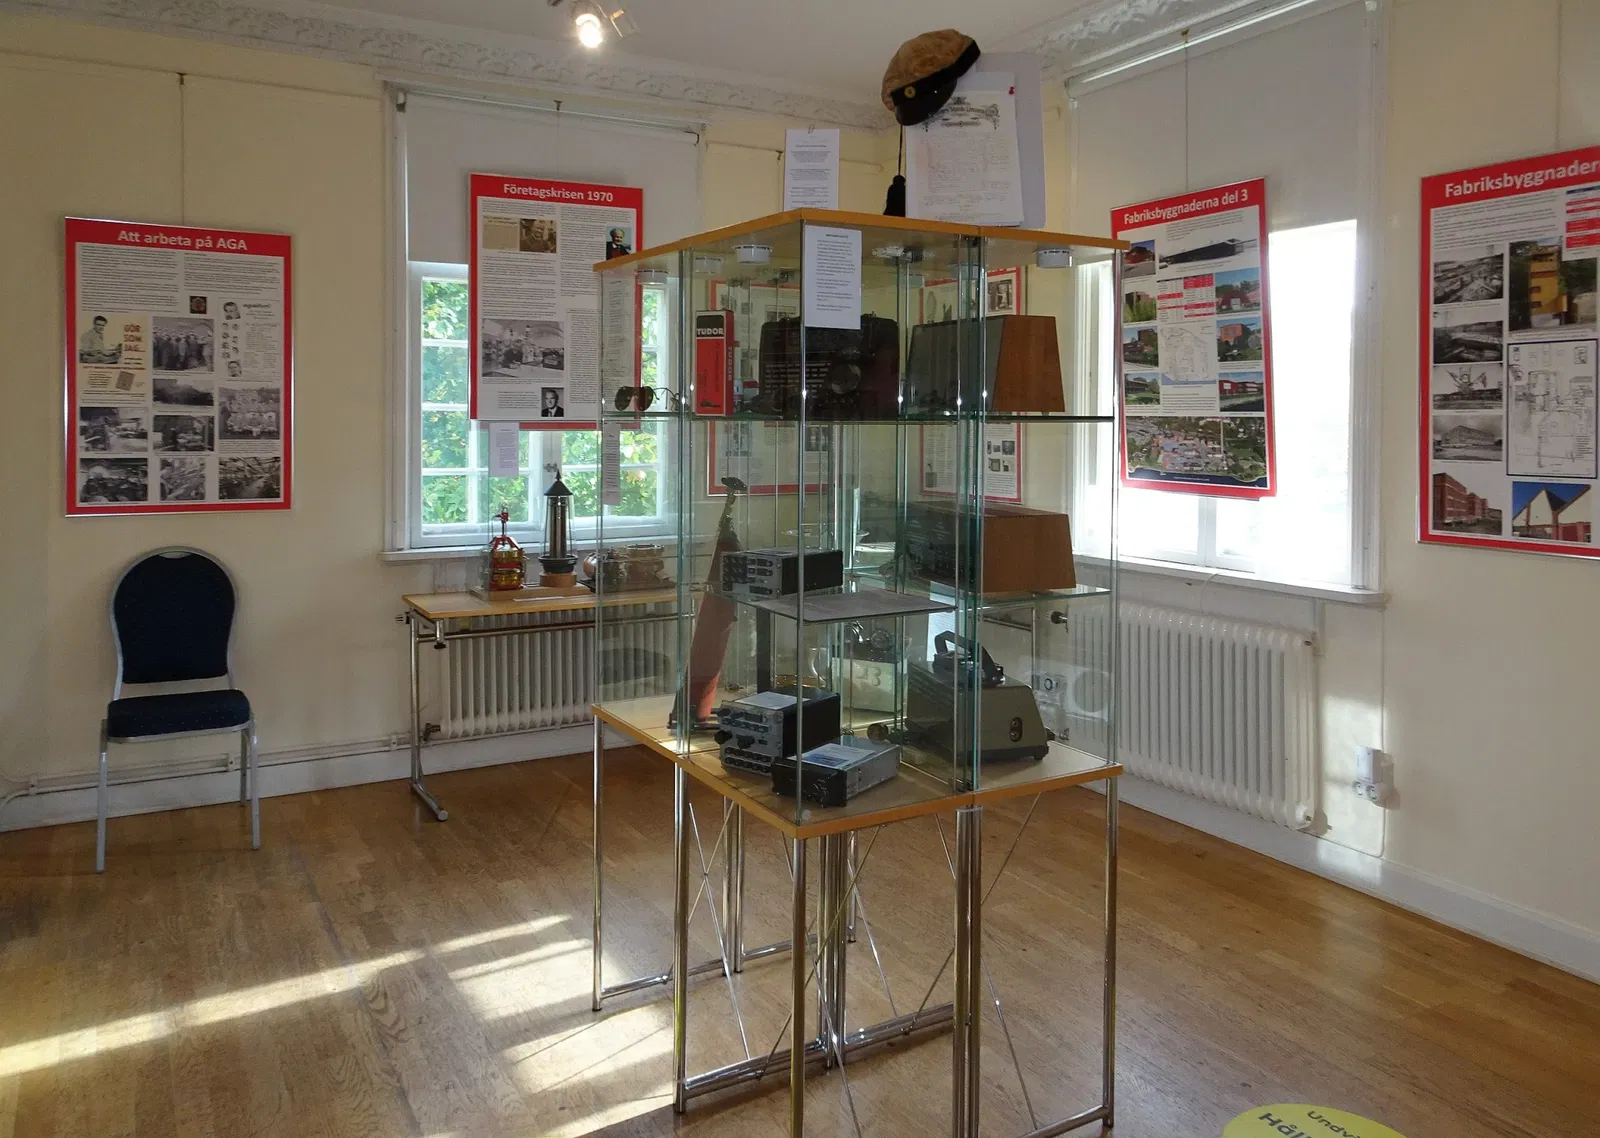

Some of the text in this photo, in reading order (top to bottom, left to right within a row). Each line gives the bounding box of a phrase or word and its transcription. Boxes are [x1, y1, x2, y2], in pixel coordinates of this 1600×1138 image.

[503, 183, 614, 203] Företagskrisen 1970
[1445, 160, 1600, 198] Fabriksbyggnader
[1124, 188, 1249, 225] Fabriksbyggnaderna del 3
[118, 230, 247, 251] Att arbeta på AGA
[1307, 1110, 1361, 1138] Undv
